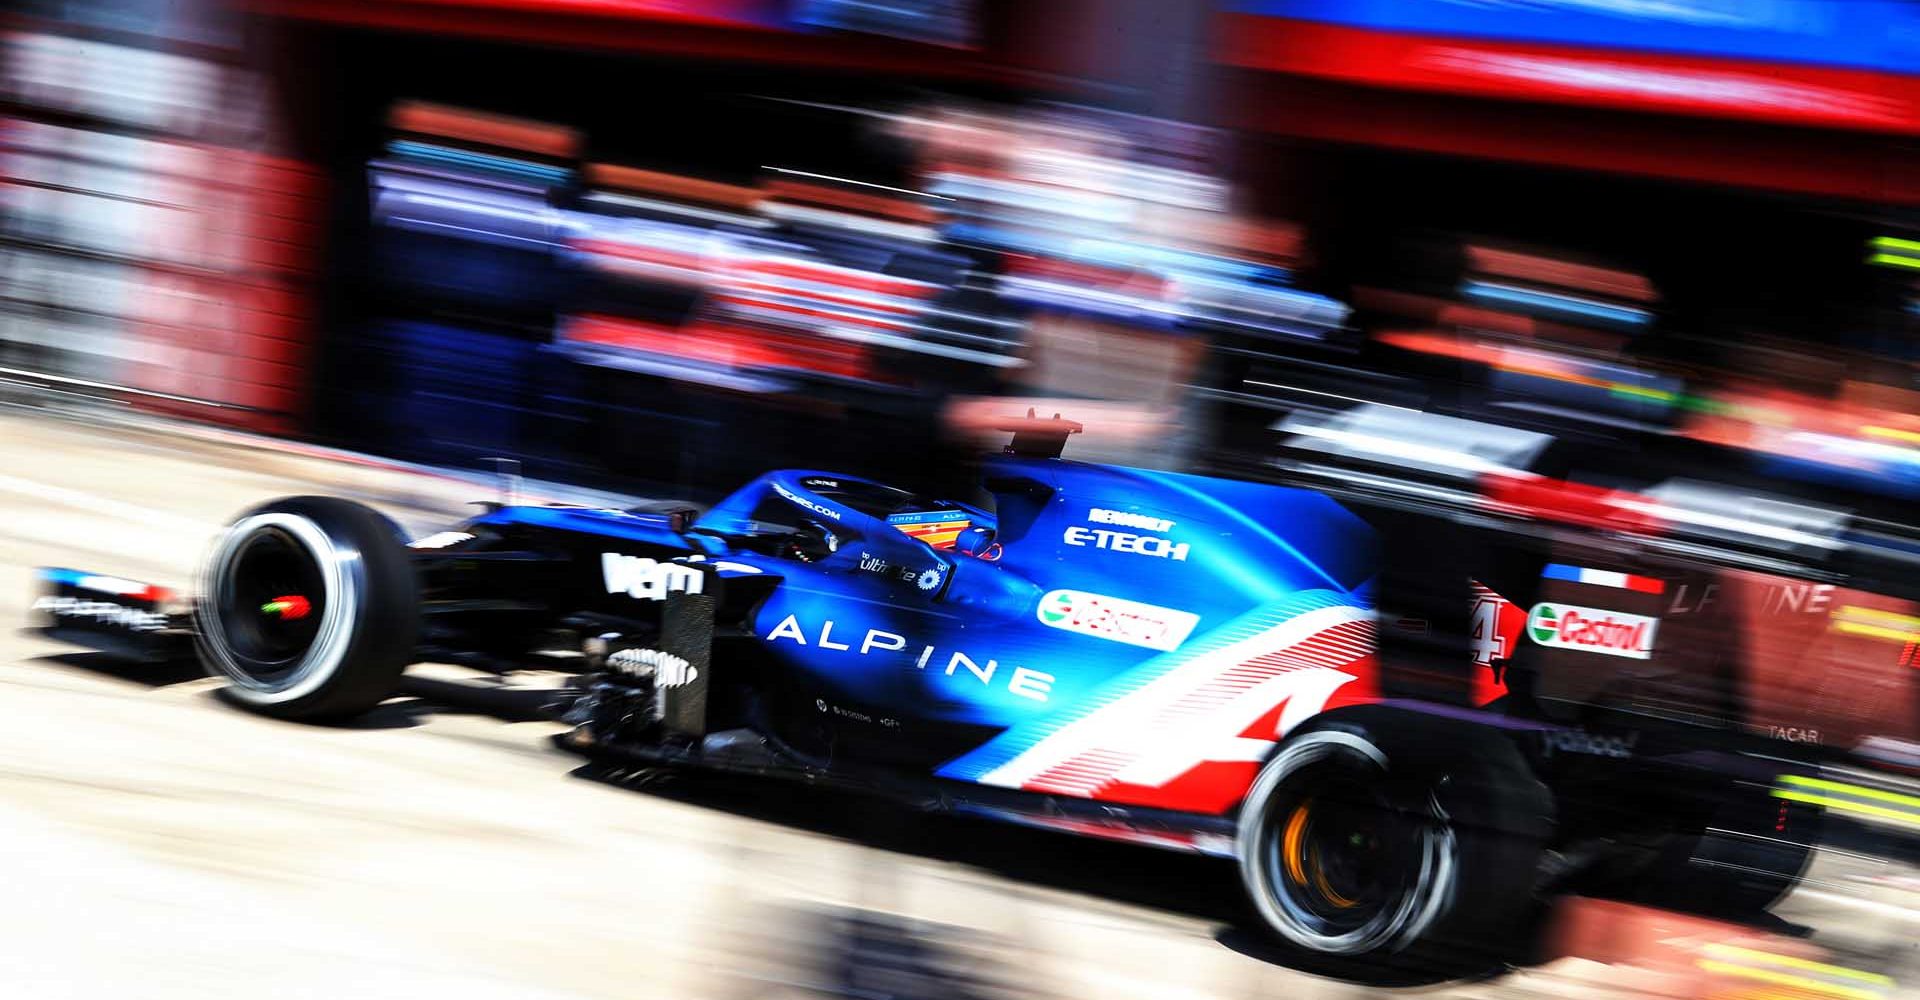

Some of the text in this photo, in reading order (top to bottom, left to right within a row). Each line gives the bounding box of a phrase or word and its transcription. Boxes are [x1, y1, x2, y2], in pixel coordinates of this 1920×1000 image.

[1064, 526, 1191, 562] E-TECH
[1558, 610, 1648, 651] Castrol
[766, 614, 1056, 702] ALPINE
